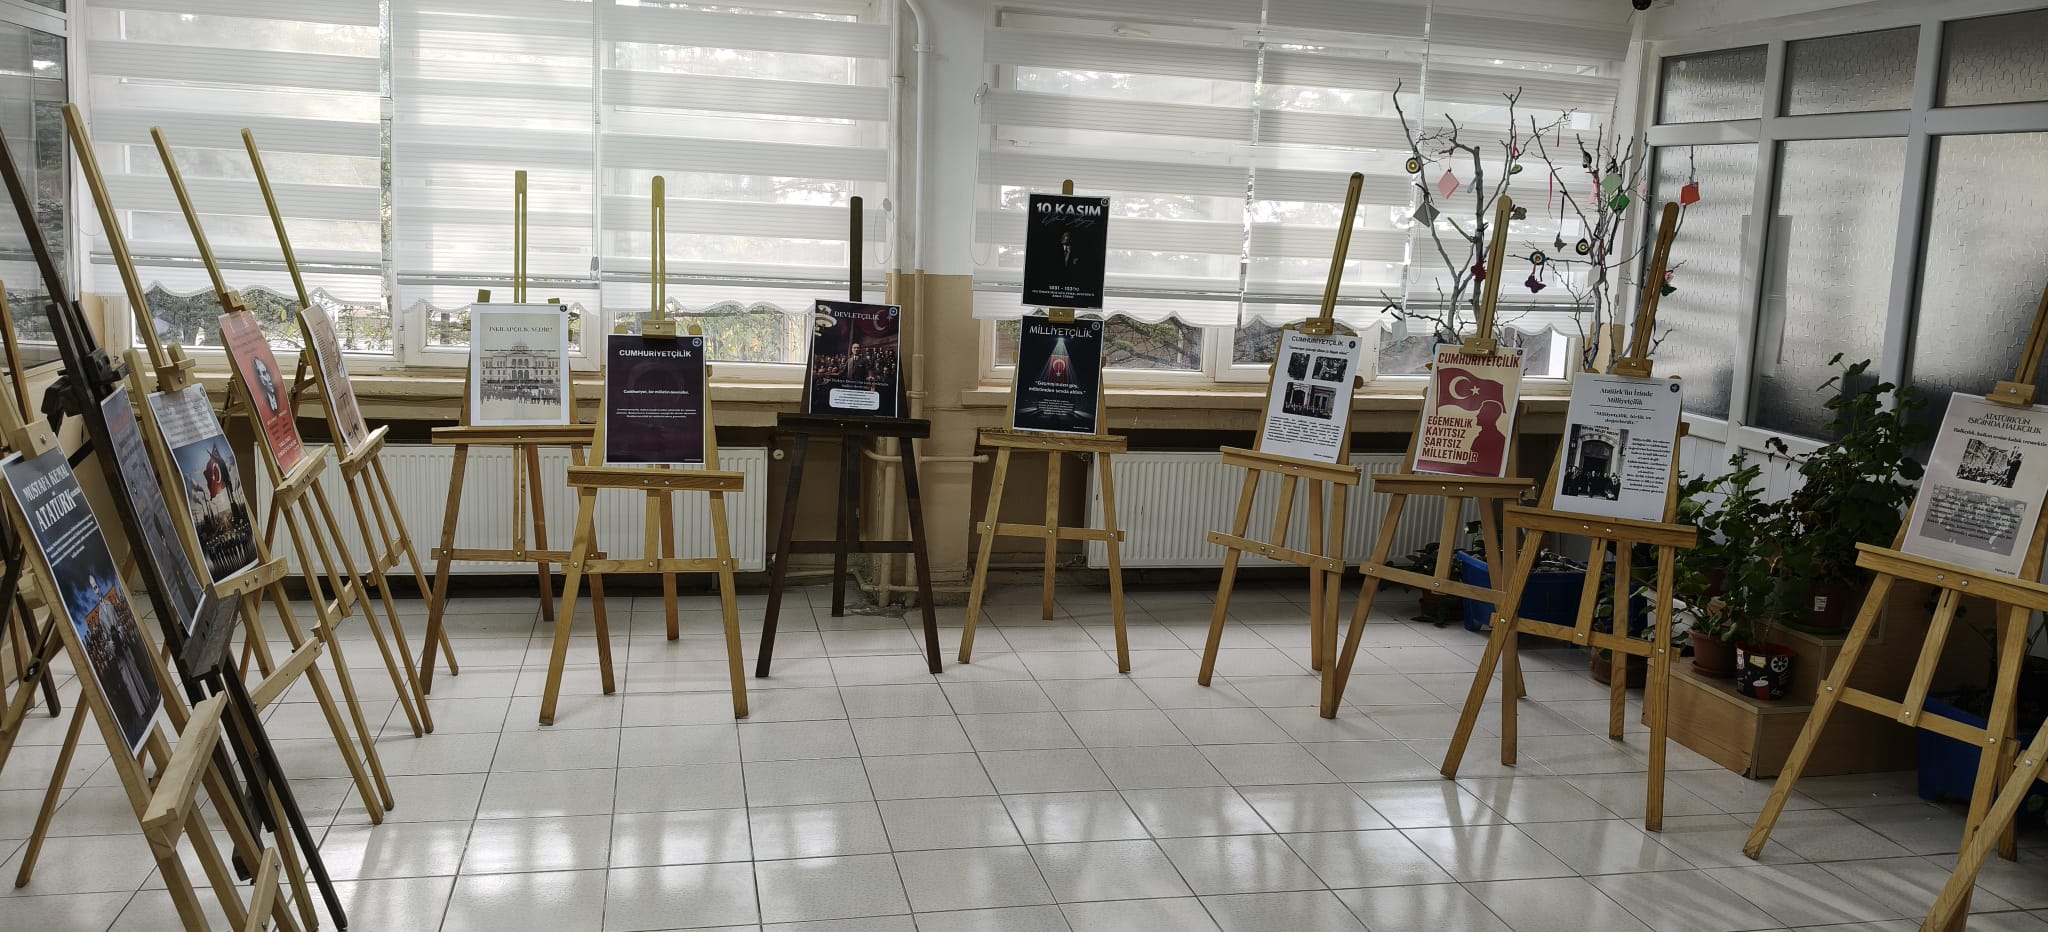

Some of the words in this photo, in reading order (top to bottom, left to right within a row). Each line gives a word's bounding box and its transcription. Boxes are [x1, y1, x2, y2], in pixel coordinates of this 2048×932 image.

[1036, 202, 1052, 214] 10
[1055, 203, 1101, 217] KASIM
[1029, 324, 1093, 339] MİLLİYETÇİLİK
[619, 349, 692, 359] CUMHURİYETÇİLİK
[1427, 415, 1473, 429] EGEMENLİK
[1425, 426, 1466, 439] KAYITSIZ
[1424, 436, 1462, 449] ŞARTSIZ
[1421, 446, 1479, 463] MİLLETİNDİR
[22, 474, 51, 502] MUSTAFA
[47, 463, 70, 486] KEMAL
[35, 488, 77, 532] ATATÜRK
